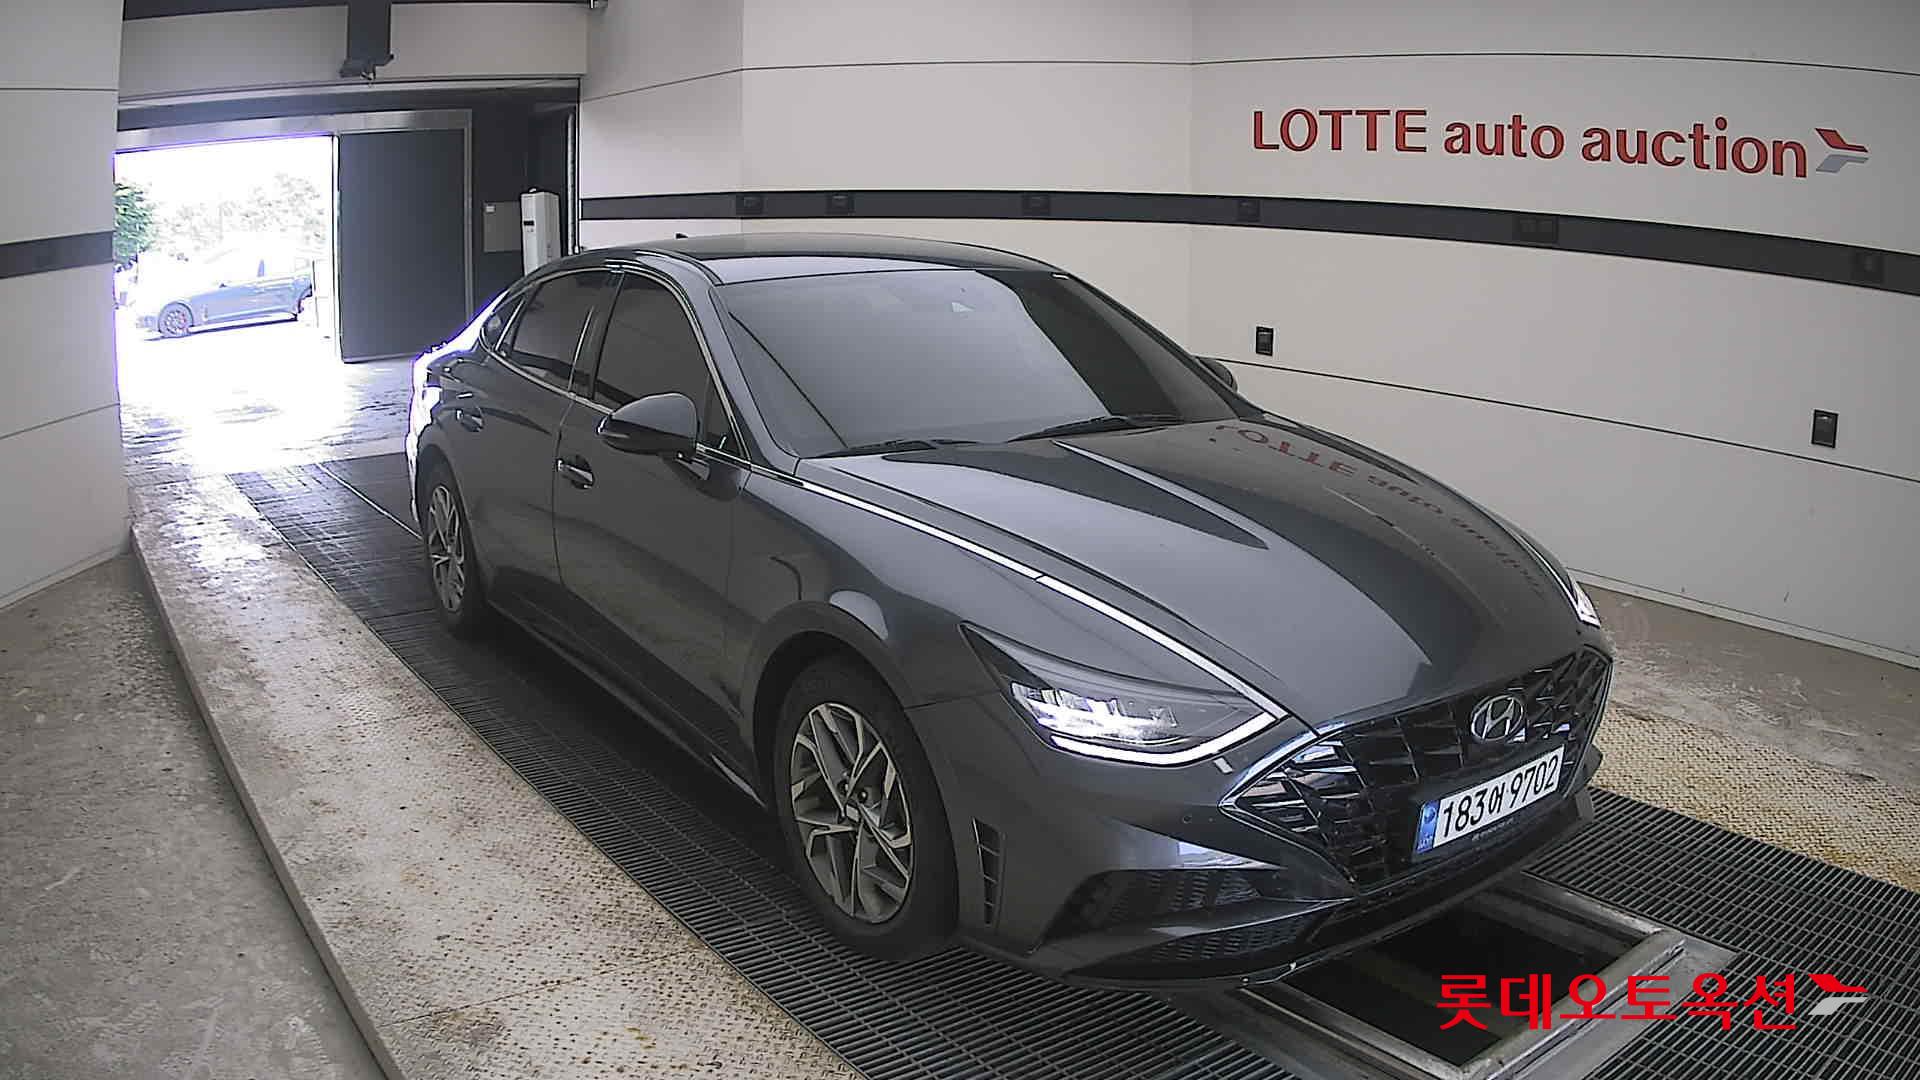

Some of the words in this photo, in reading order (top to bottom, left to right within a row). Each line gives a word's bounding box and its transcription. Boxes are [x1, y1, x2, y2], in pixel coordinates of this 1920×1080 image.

[1252, 109, 1428, 153] LOTTE
[1443, 114, 1566, 159] auto
[1580, 116, 1808, 178] auction
